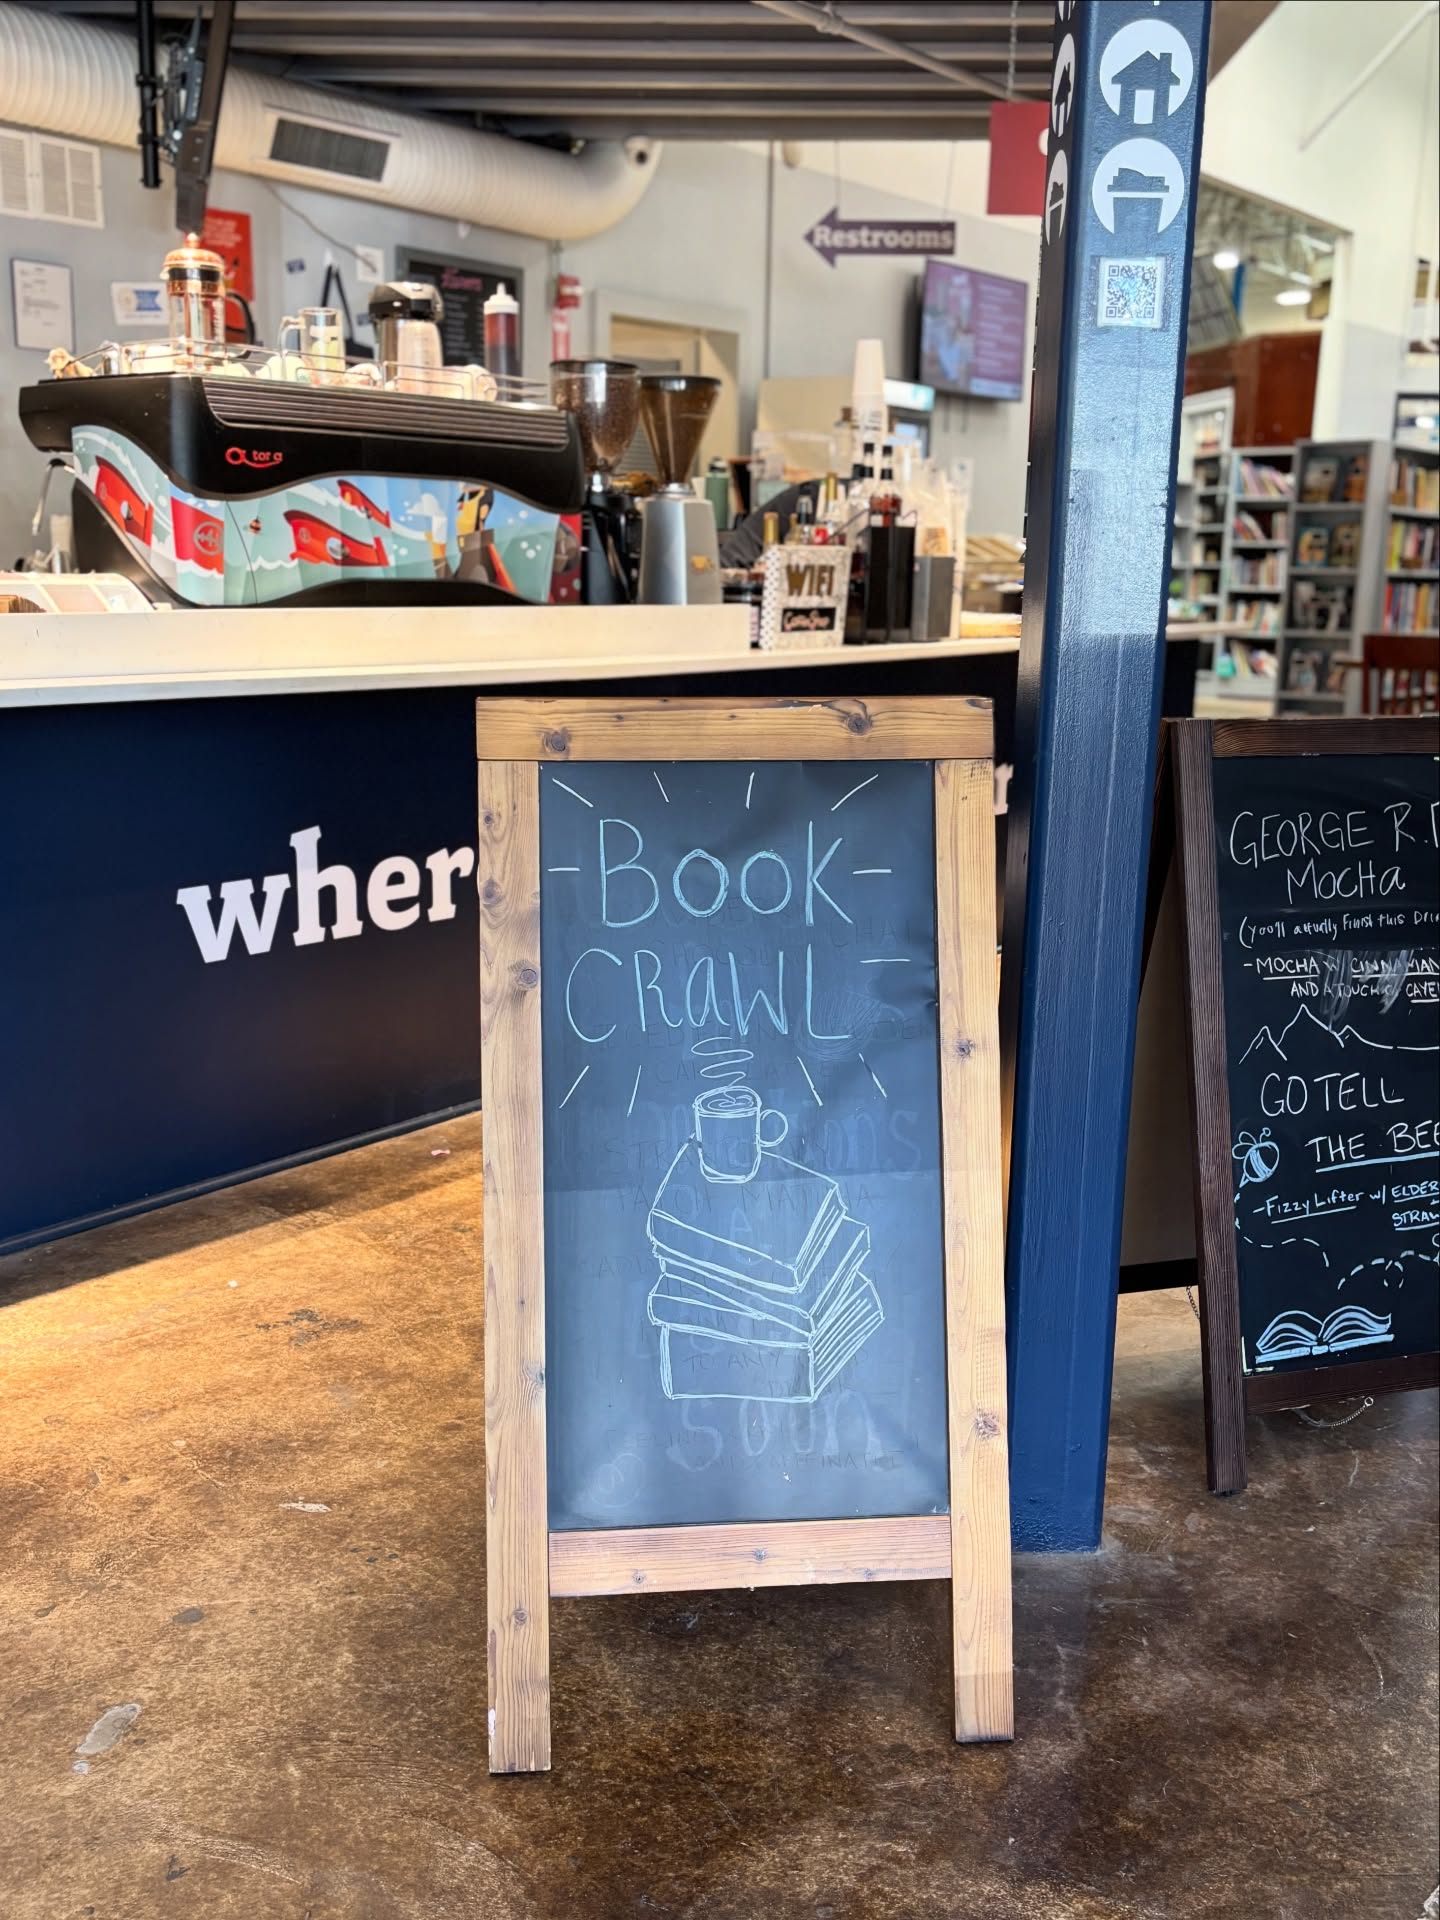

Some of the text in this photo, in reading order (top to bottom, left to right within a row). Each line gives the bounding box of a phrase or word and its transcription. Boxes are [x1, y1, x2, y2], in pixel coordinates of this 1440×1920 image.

[813, 227, 955, 250] Restrooms
[786, 564, 835, 596] WIFI
[1230, 811, 1375, 869] GEORGE
[599, 818, 854, 928] BOOK
[175, 825, 480, 965] wher
[1377, 913, 1406, 928] this
[1291, 981, 1320, 998] AND
[1304, 1132, 1367, 1164] THE
[1314, 1190, 1365, 1208] Lifter
[1369, 1184, 1386, 1206] w/
[1391, 1180, 1439, 1199] ELDER
